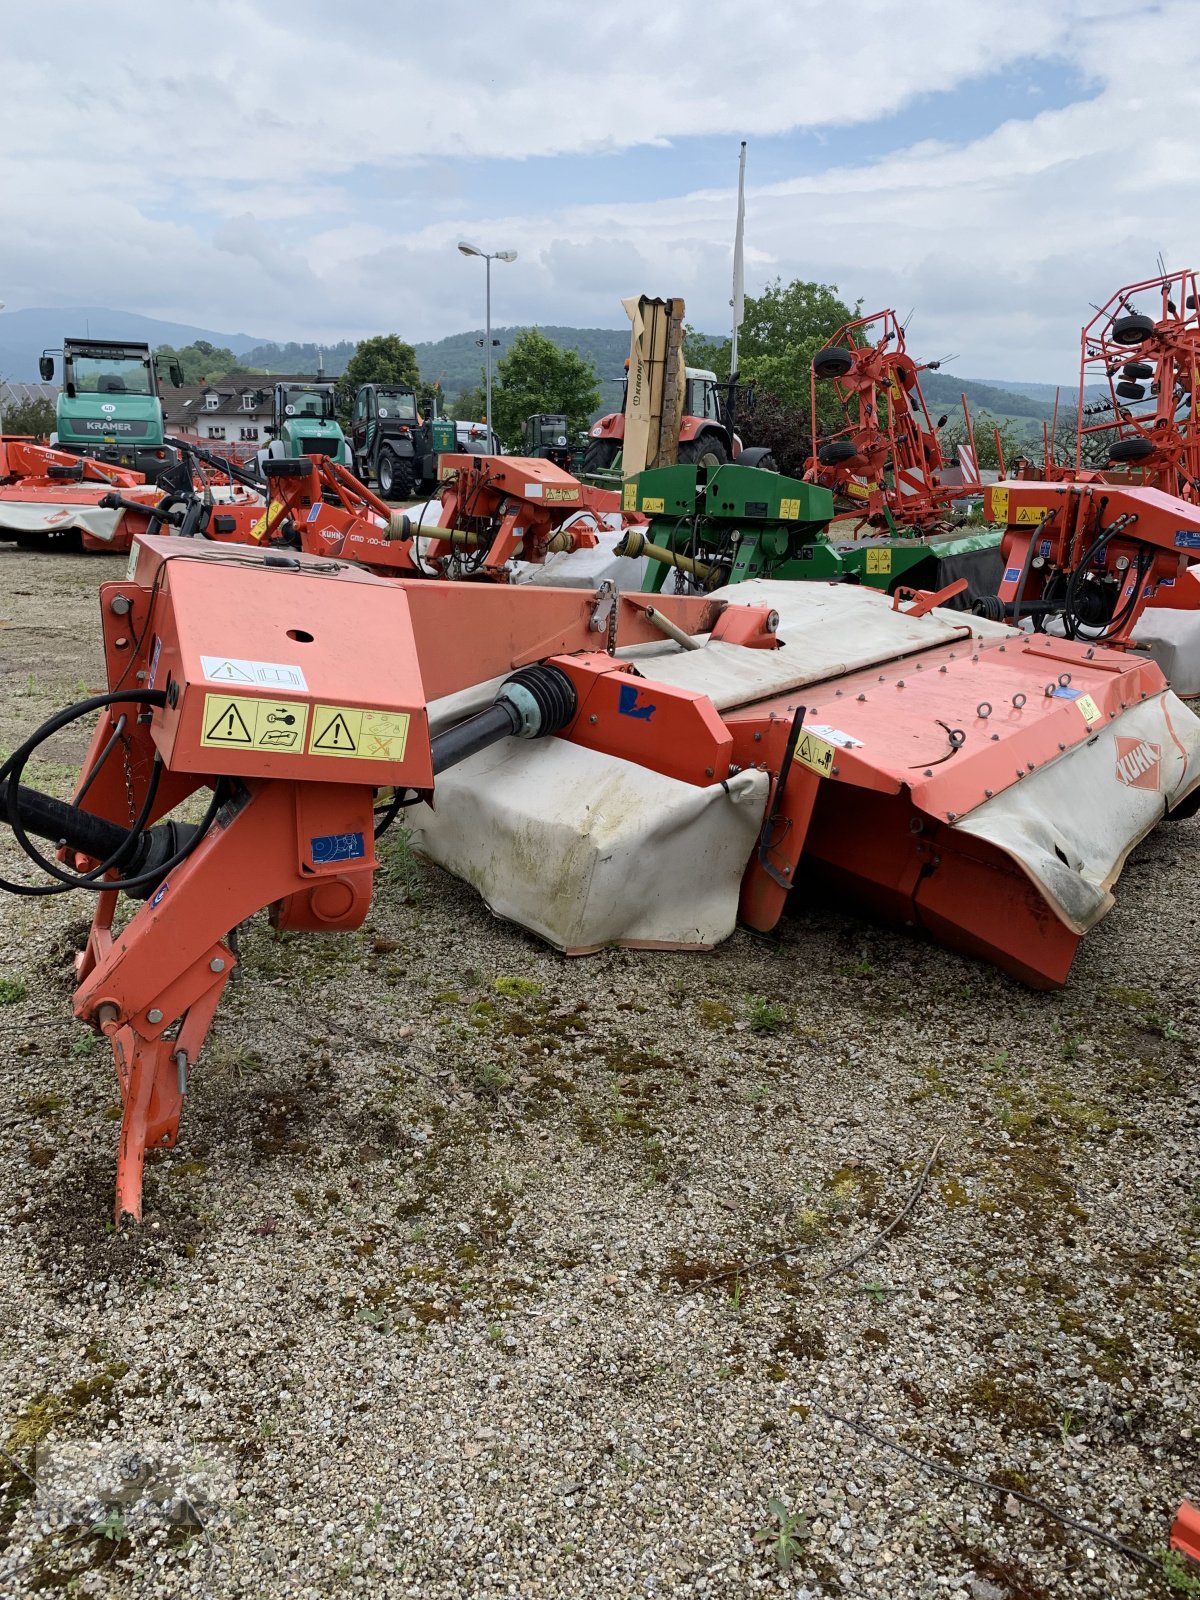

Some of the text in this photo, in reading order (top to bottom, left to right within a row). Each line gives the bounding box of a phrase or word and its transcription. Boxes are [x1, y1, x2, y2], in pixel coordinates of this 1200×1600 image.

[86, 421, 131, 431] KRAMER
[321, 530, 342, 540] KUHN
[1116, 741, 1162, 786] KUHN
